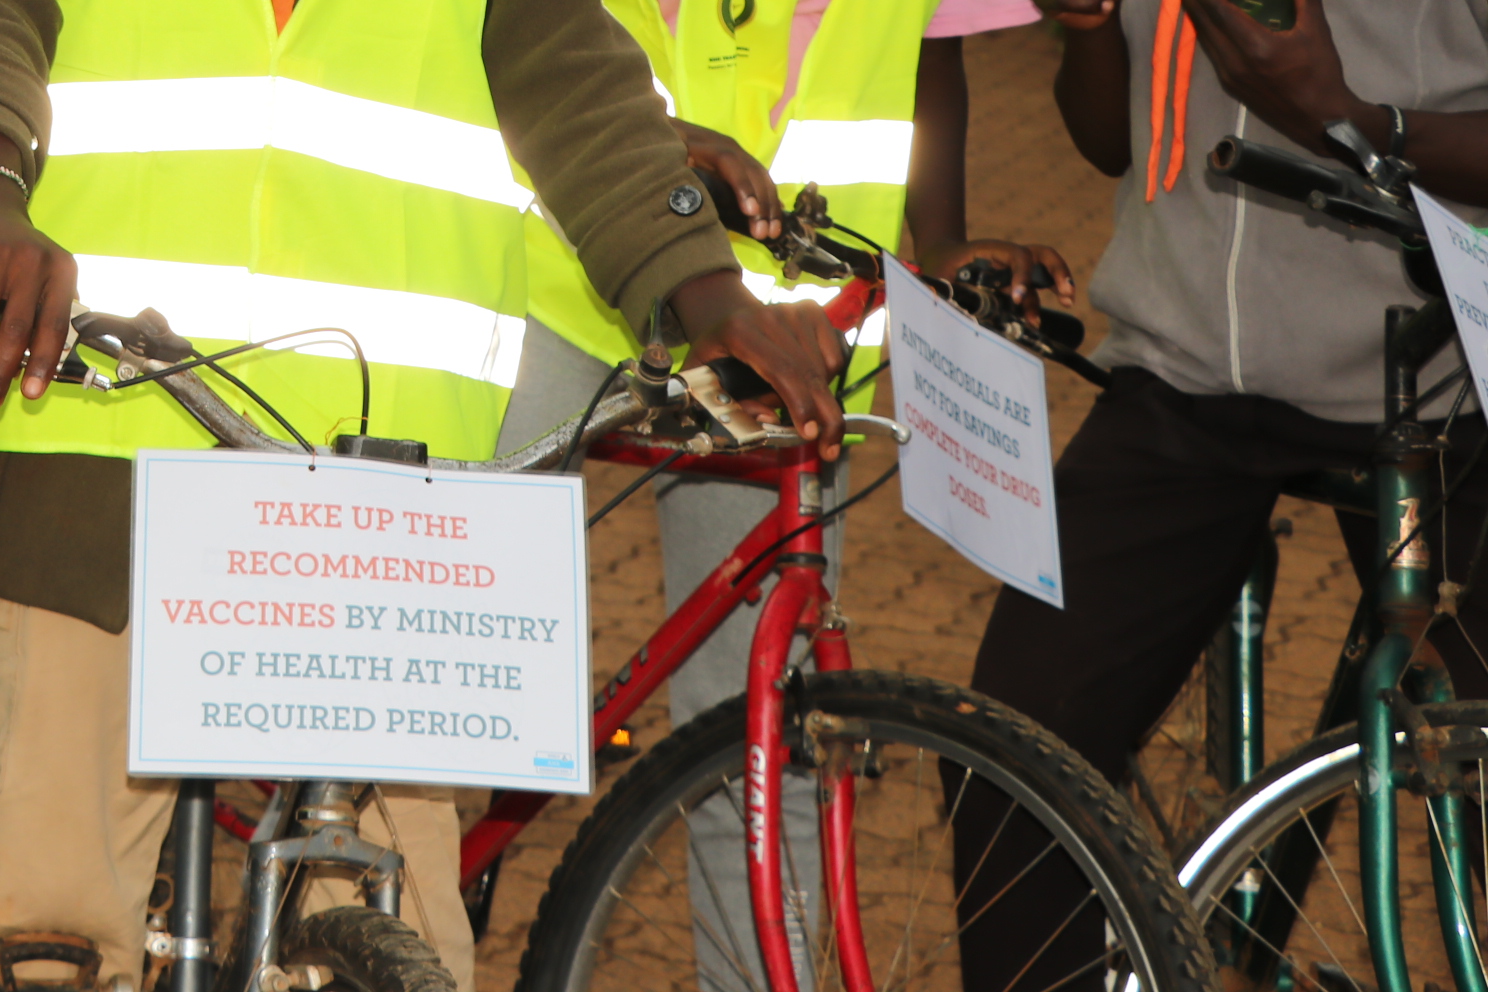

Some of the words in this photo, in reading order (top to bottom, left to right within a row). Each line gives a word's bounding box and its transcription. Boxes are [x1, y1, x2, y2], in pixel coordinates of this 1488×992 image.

[901, 322, 1000, 410] ANTIMICROBIALS
[1003, 395, 1031, 427] ARE
[913, 369, 937, 405] NOT
[939, 390, 962, 425] FOR
[963, 408, 1020, 459] SAVINGS
[904, 401, 962, 463] COMPLETE
[962, 446, 999, 486] YOUR
[1000, 469, 1041, 508] DRUG
[254, 500, 342, 528] TAKE
[352, 506, 394, 531] UP
[403, 511, 468, 540] THE
[227, 550, 495, 588] RECOMMENDED
[162, 599, 335, 629] VACCINES
[345, 605, 387, 630] BY
[397, 607, 559, 643] MINISTRY
[200, 651, 246, 676] OF
[255, 652, 393, 682] HEALTH
[403, 659, 445, 684] AT
[455, 662, 521, 690] THE
[201, 702, 376, 733] REQUIRED
[386, 708, 520, 742] PERIOD.
[748, 744, 768, 864] GIANT
